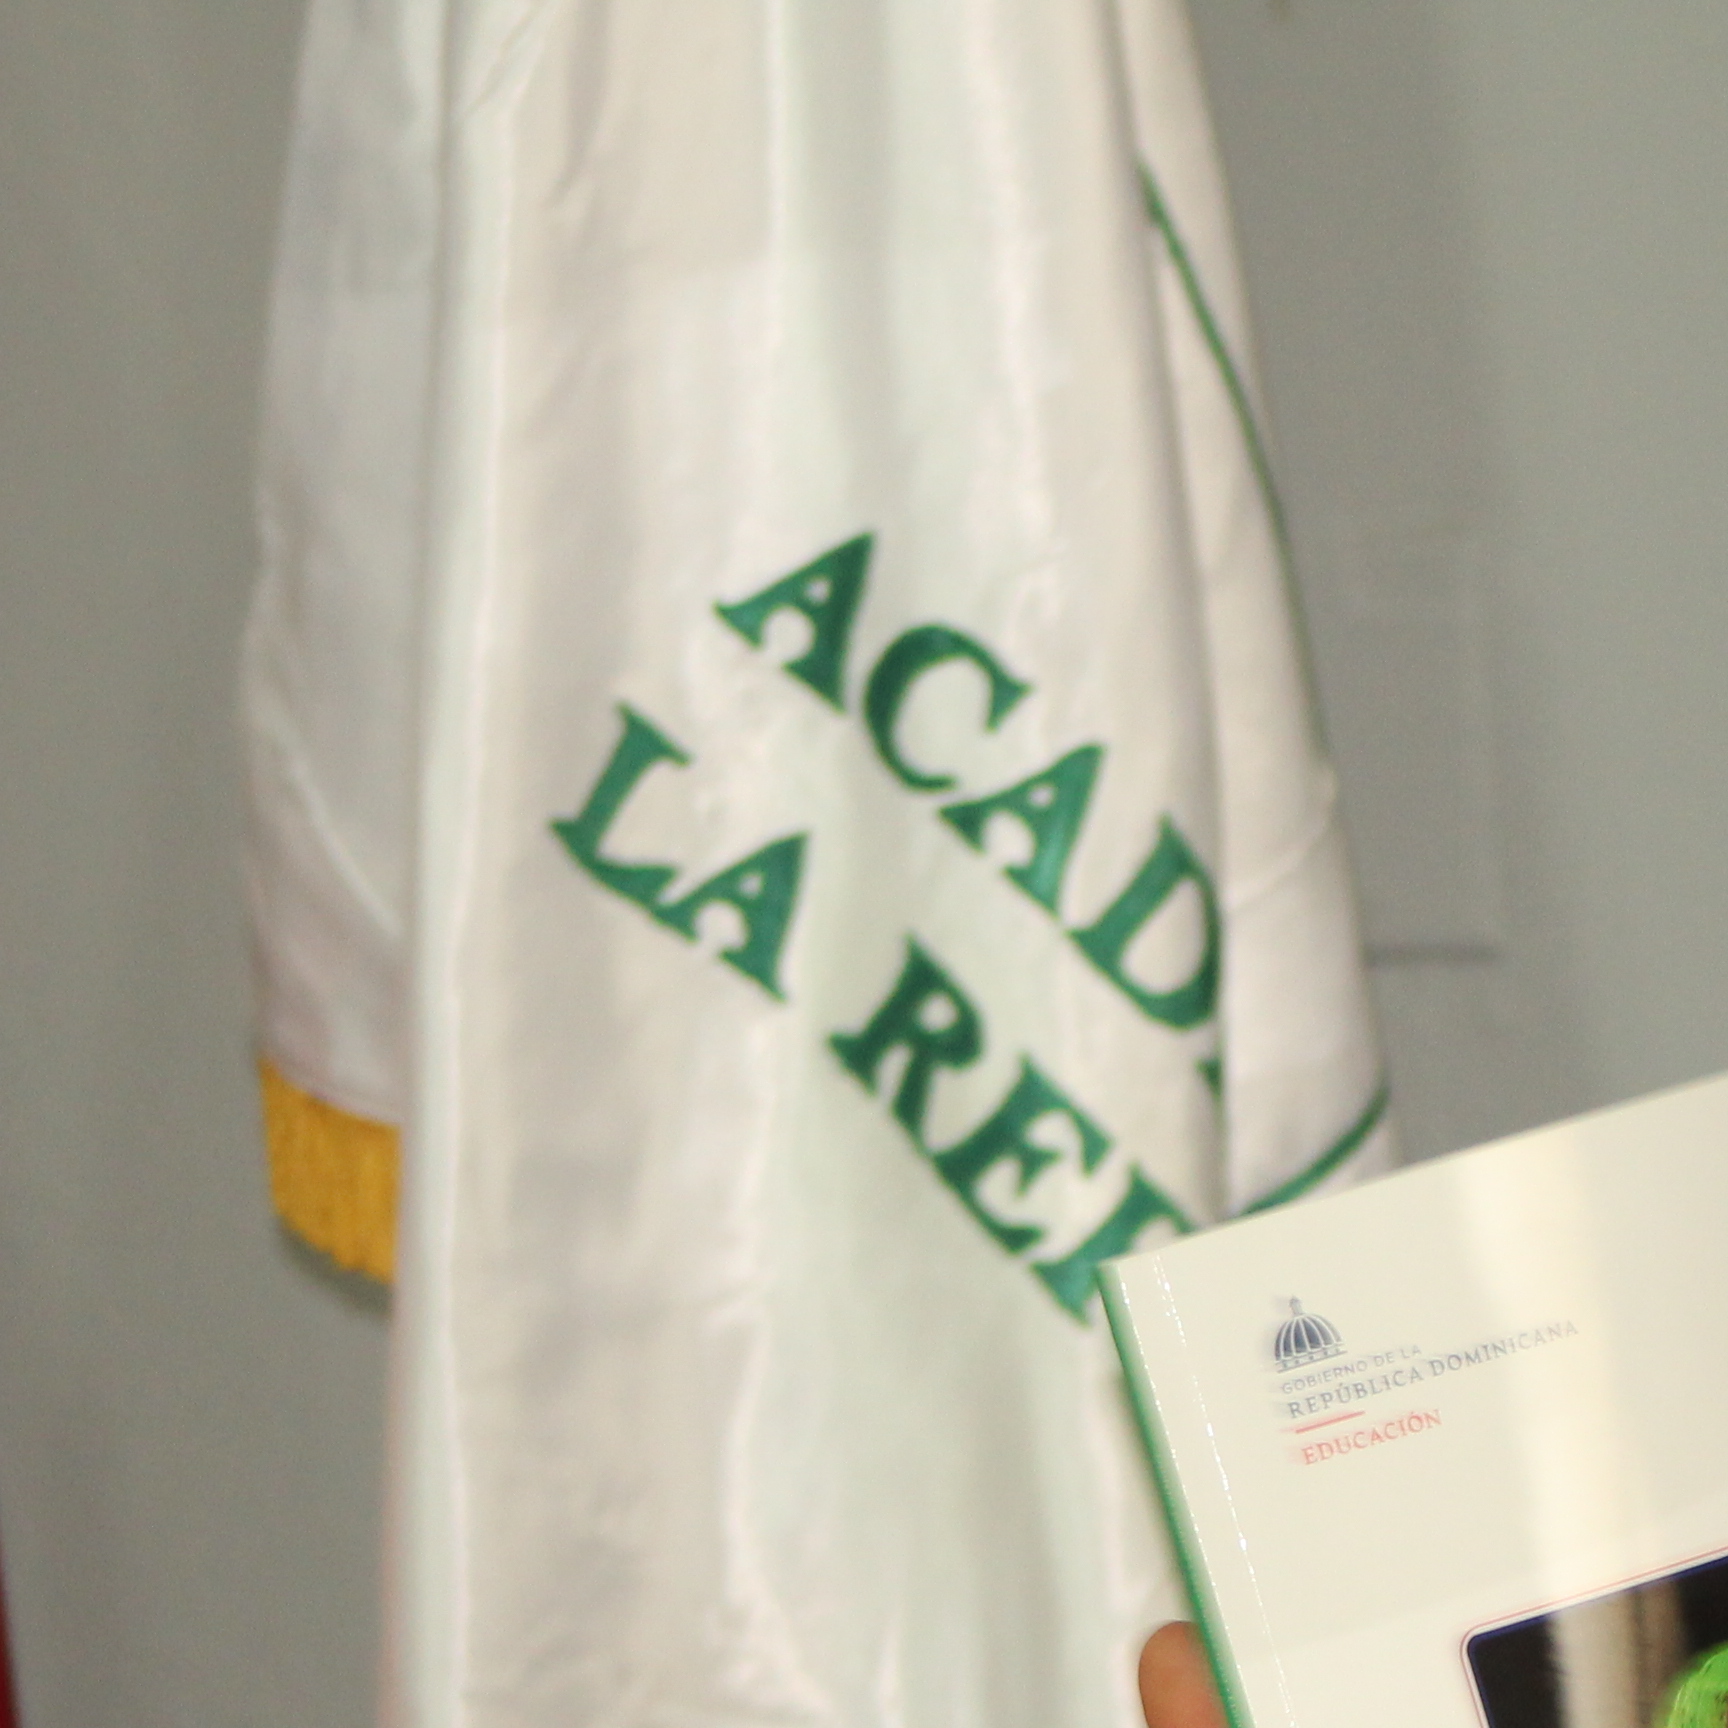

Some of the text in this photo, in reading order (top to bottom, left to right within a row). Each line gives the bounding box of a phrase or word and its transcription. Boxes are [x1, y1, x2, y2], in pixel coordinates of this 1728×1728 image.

[548, 701, 810, 1004] LA
[712, 530, 1225, 1104] ACAD
[1280, 1345, 1423, 1395] GOBIERNO DE LA
[1287, 1319, 1580, 1420] REPÚBLICA DOMINICANA
[1301, 1409, 1443, 1467] EDUCACIÓN
